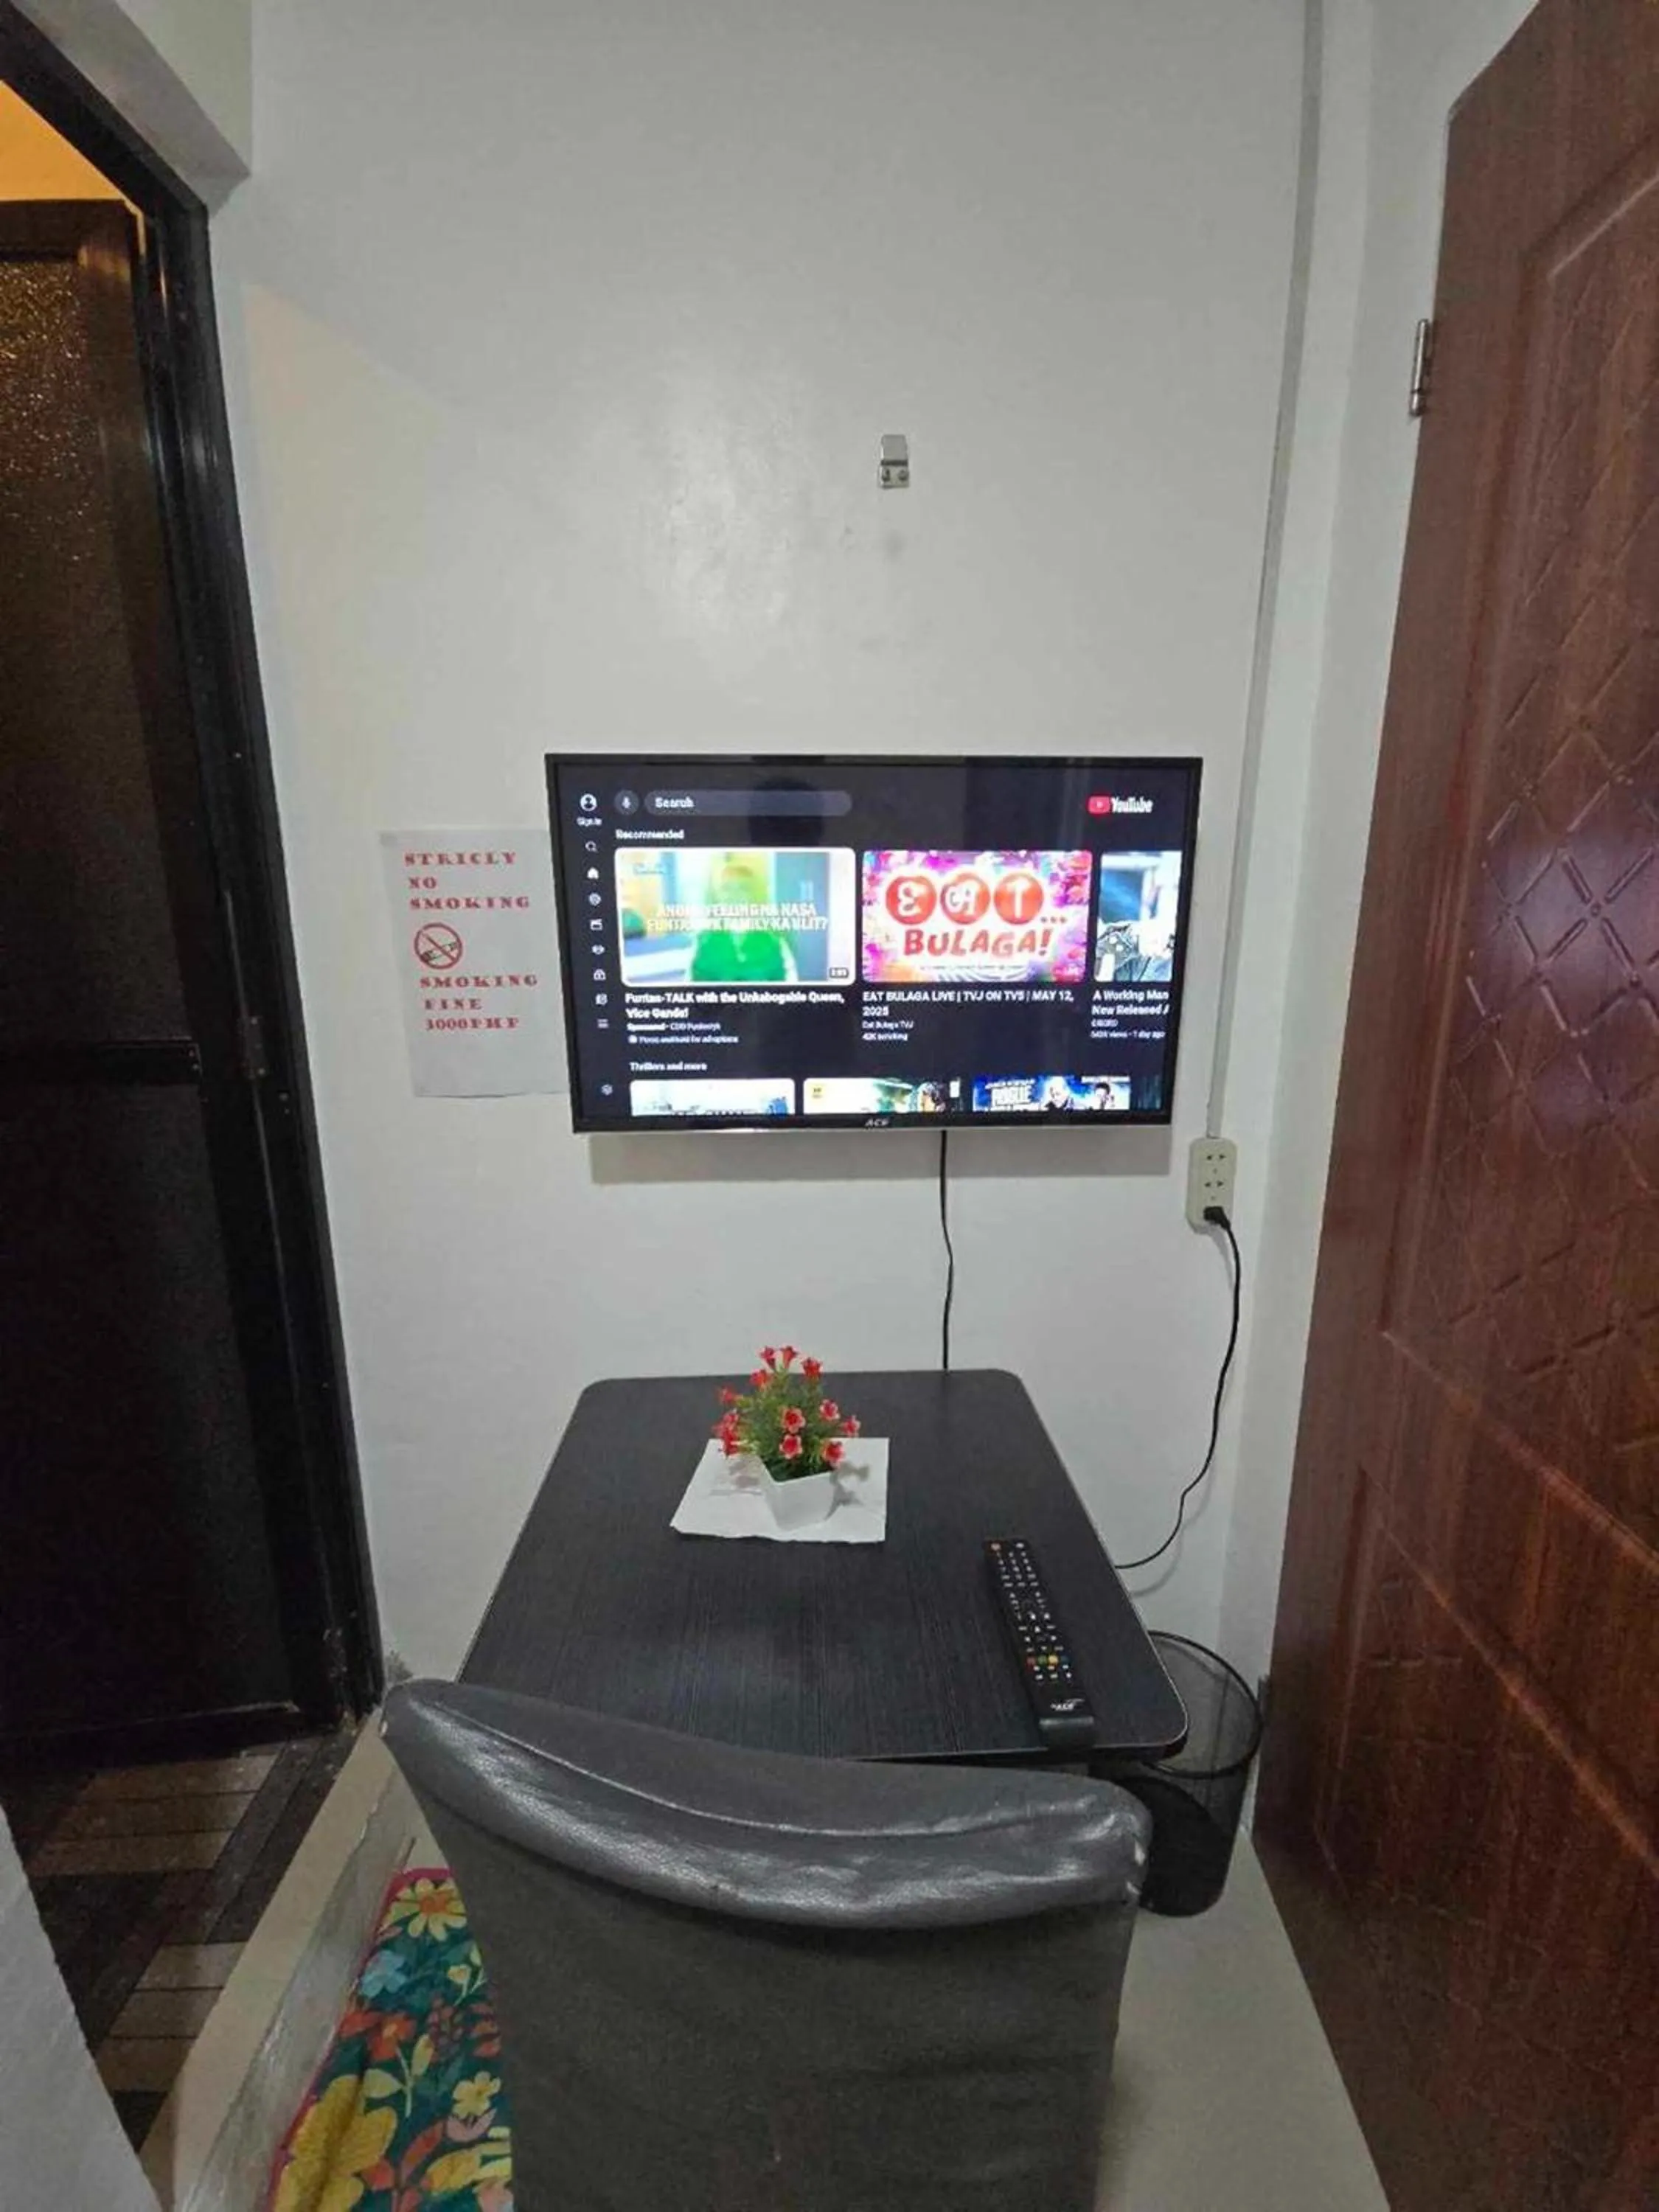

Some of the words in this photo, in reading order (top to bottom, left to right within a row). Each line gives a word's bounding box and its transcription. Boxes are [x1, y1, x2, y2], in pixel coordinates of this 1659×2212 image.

[655, 796, 695, 808] Search
[1110, 796, 1154, 814] YouTube
[615, 829, 685, 840] Recommended
[404, 851, 517, 866] STRICLY
[408, 876, 438, 890] NO
[409, 896, 530, 910] SMOKING
[903, 928, 1053, 957] BULAGA!
[420, 974, 538, 989] SMOKING
[720, 992, 738, 1004] the
[862, 991, 884, 1001] EAT
[886, 991, 930, 1001] BULAGA
[931, 991, 956, 1001] LIVE
[963, 990, 984, 1001] TVJ
[985, 990, 1002, 1001] ON
[1032, 990, 1057, 1001] MAY
[1103, 990, 1145, 1003] Working
[425, 998, 483, 1011] FINE
[1092, 1004, 1116, 1015] New
